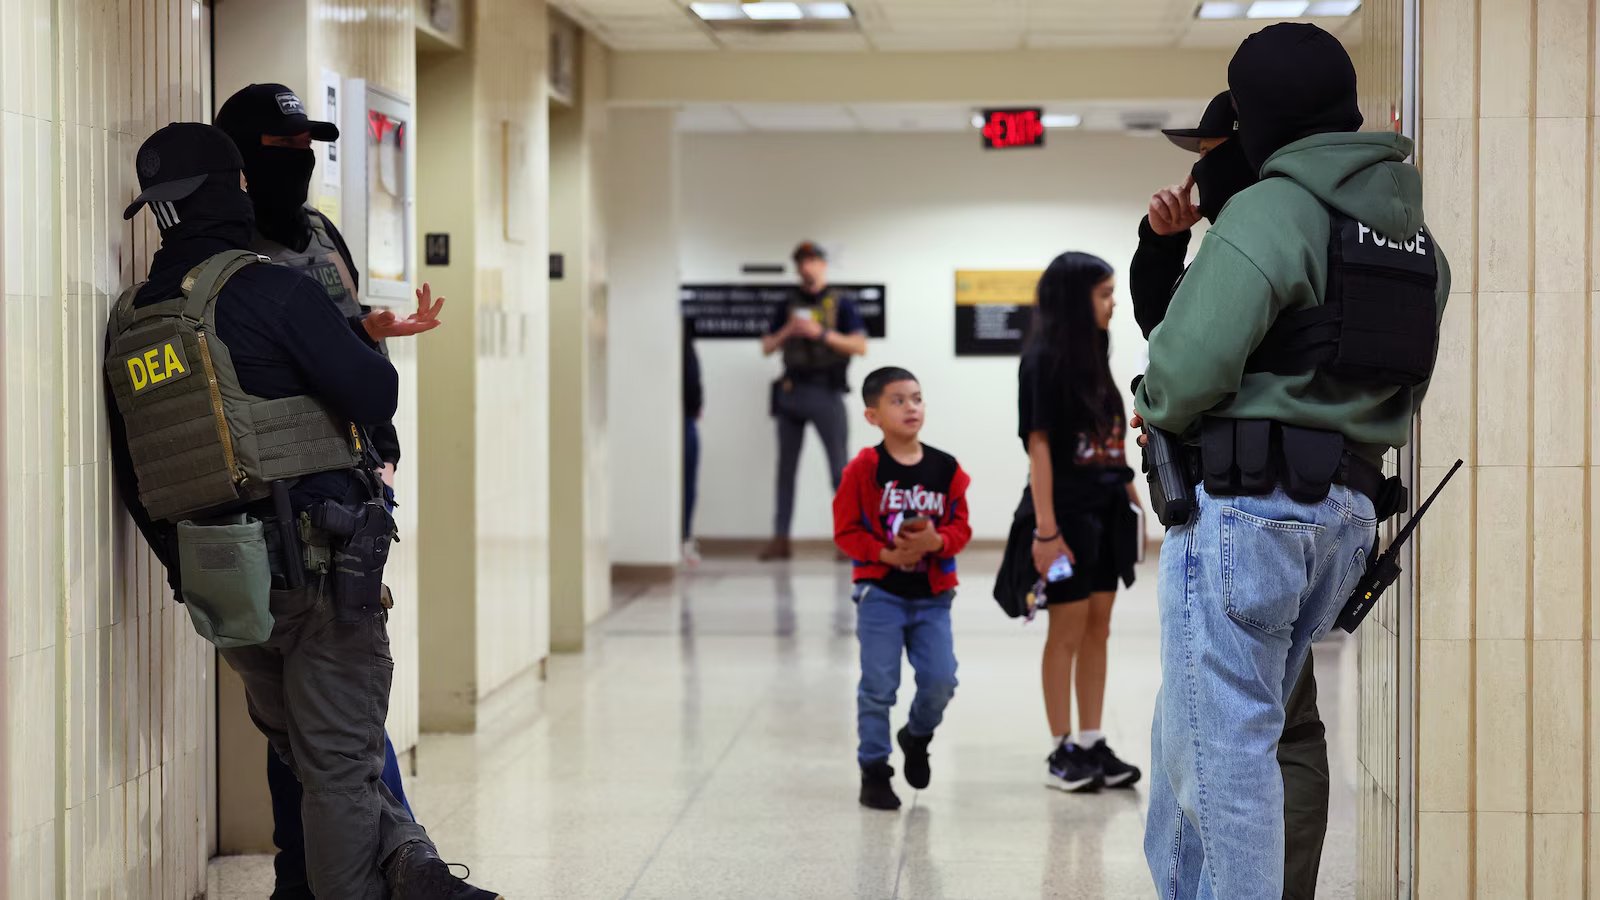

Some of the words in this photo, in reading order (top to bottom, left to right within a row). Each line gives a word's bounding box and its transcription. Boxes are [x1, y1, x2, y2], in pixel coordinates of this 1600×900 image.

[989, 111, 1037, 148] EXIT
[1358, 221, 1426, 256] POE
[127, 343, 185, 391] DEA
[880, 480, 945, 516] VENOM
